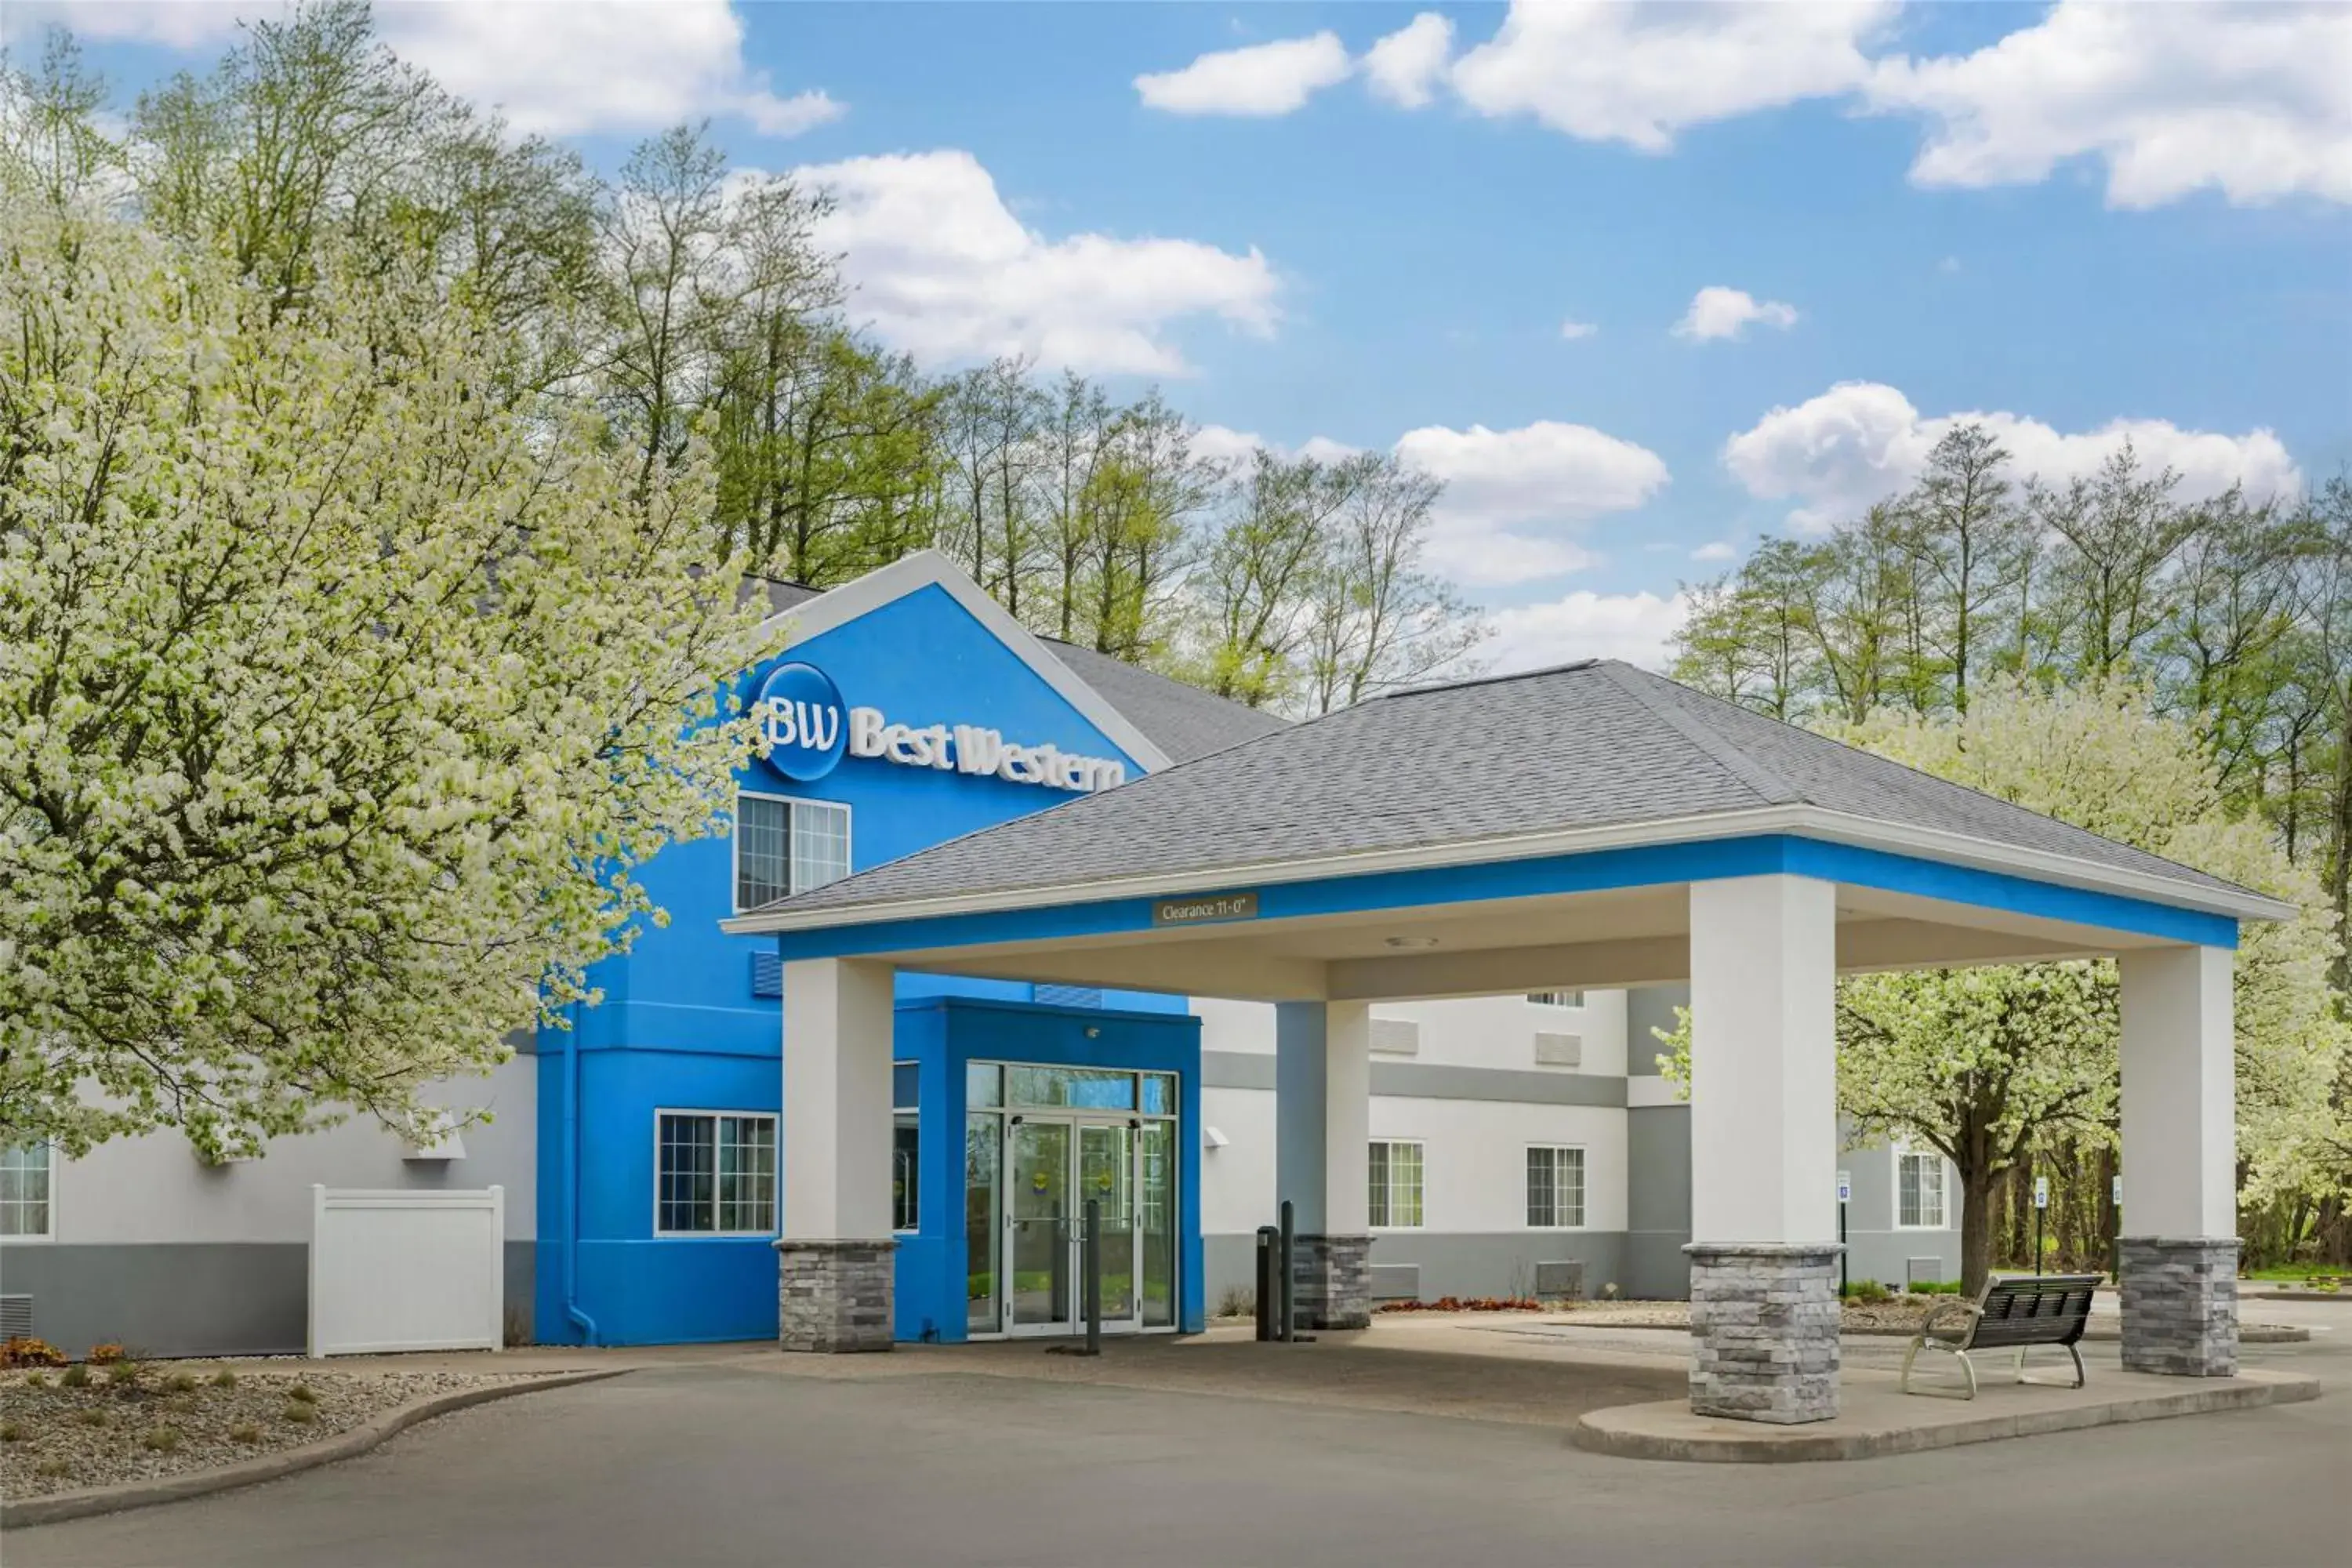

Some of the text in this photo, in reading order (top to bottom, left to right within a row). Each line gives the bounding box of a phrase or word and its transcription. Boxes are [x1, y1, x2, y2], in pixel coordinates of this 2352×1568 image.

[768, 696, 838, 751] BW
[849, 706, 1125, 791] Best Western
[1163, 904, 1214, 920] Clearance
